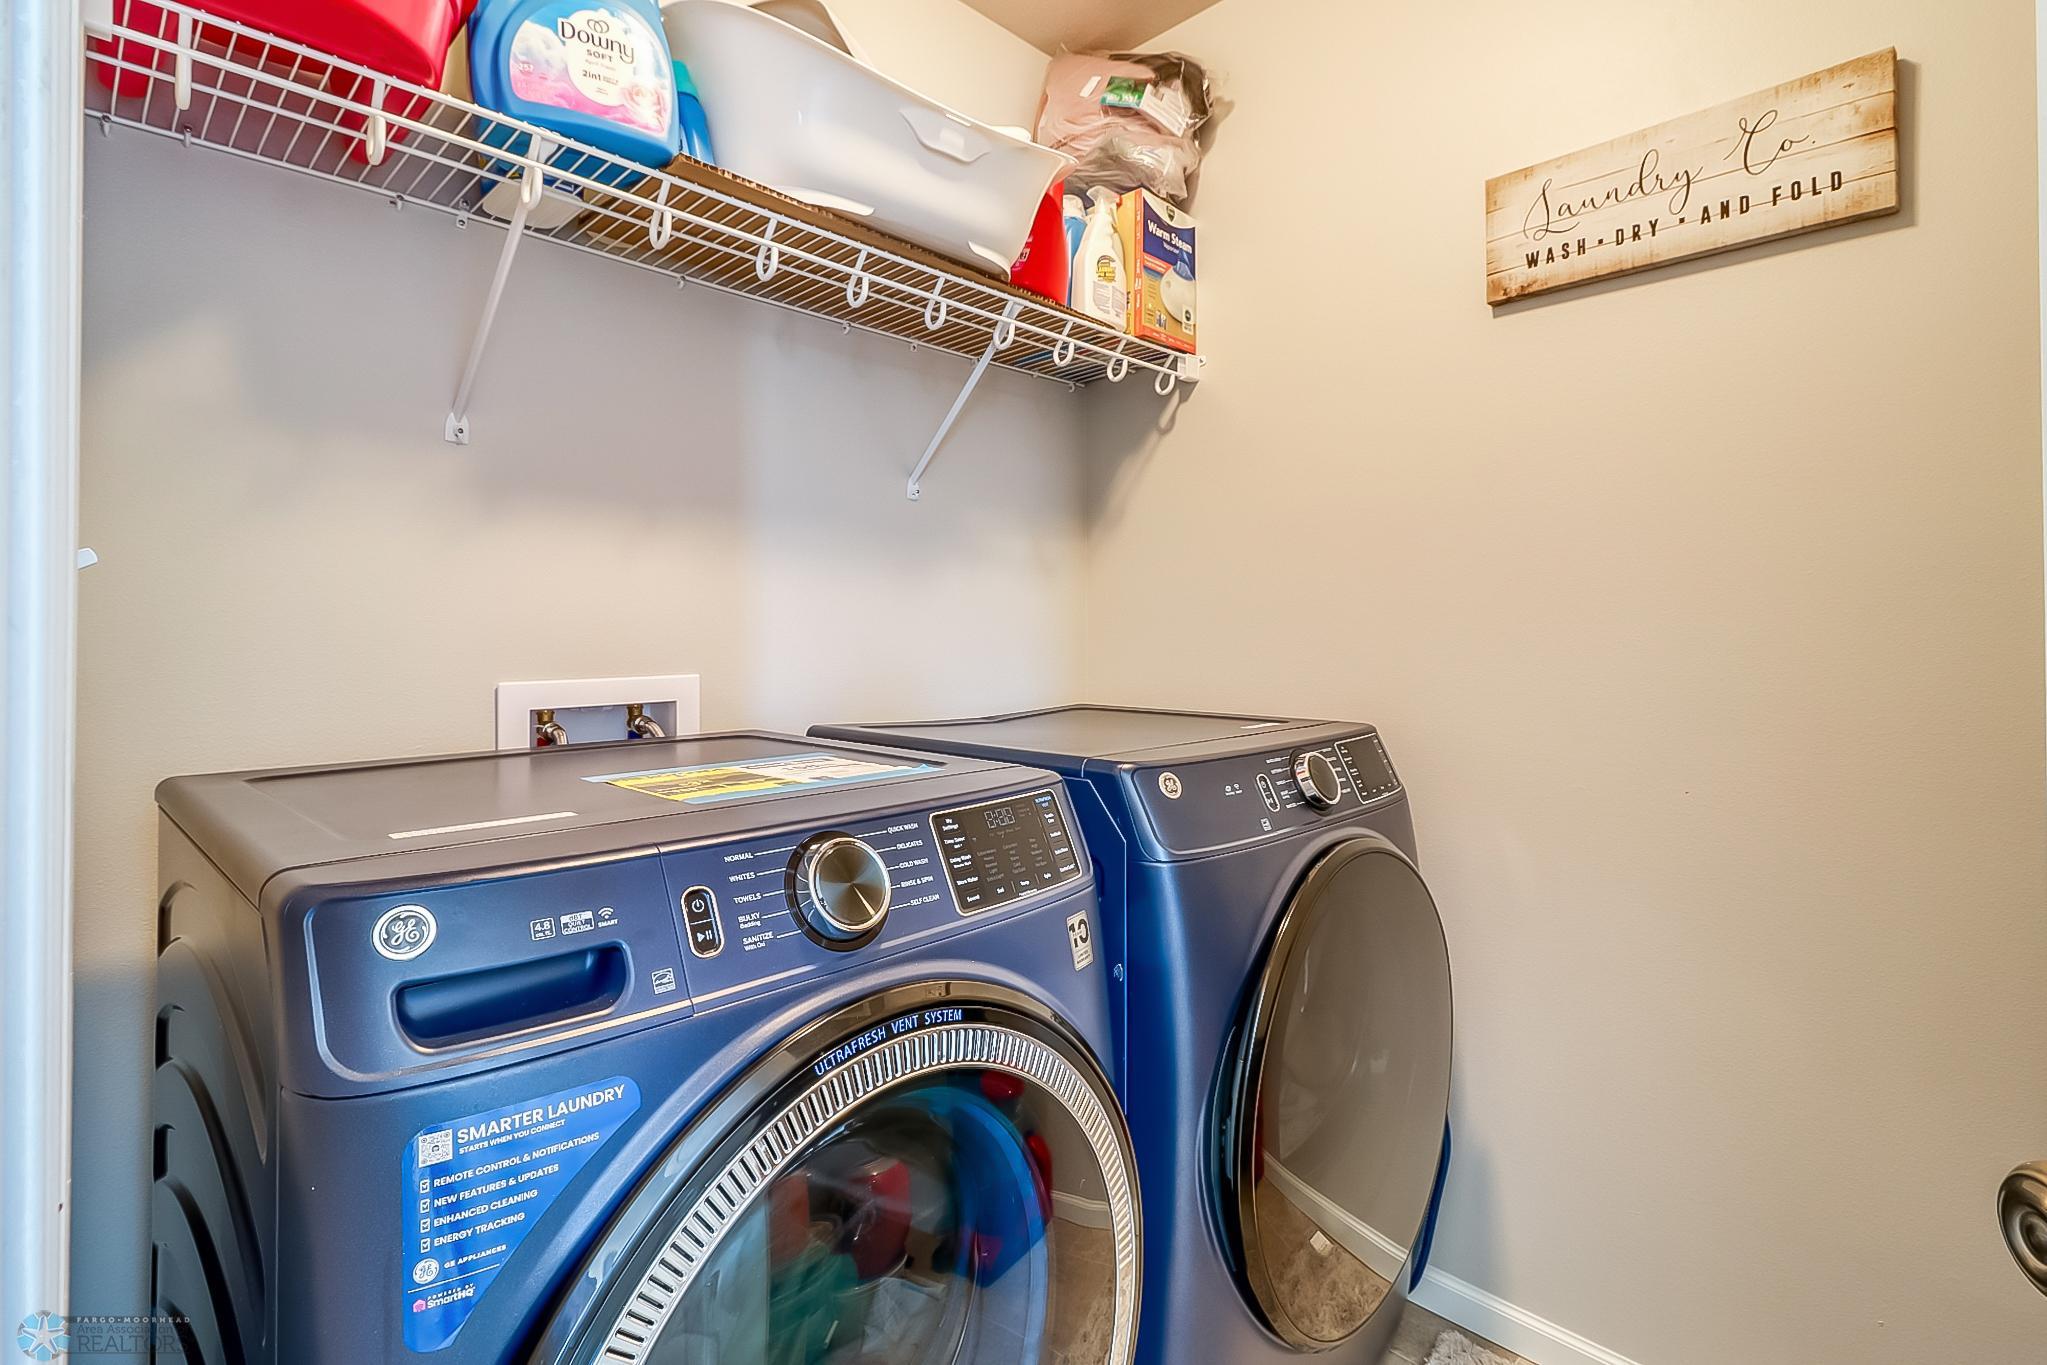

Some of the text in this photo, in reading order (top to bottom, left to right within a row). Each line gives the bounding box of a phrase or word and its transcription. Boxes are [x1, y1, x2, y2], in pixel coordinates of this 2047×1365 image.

[561, 20, 634, 65] Downy
[586, 49, 613, 63] SOFT
[1523, 109, 1817, 241] Laundry Co.
[1526, 169, 1843, 270] WASH DRY AND FOLD
[1147, 219, 1193, 255] Warm Steam
[904, 822, 919, 831] WASH
[896, 839, 924, 850] DELICATES
[723, 851, 754, 863] NORMAL
[899, 860, 913, 869] COLD
[728, 871, 756, 883] WHITES
[733, 892, 762, 904] TOWELS
[534, 921, 551, 932] 4.8
[597, 918, 618, 928] SMART
[737, 911, 761, 923] BULKY
[742, 931, 774, 944] SANITIZE
[815, 1008, 963, 1076] ULTRAFRESH VENT SYSTEM
[457, 1084, 625, 1144] SMARTER LAUNDRY
[458, 1119, 566, 1155] STARTS WHEN YOU CONNECT
[433, 1131, 600, 1188] REMOTE CONTROL & NOTIFICATIONS
[433, 1163, 560, 1208] NEW FEATURES & UPDATES
[433, 1189, 538, 1227] ENHANCED CLEANING
[433, 1212, 526, 1247] ENERGY TRACKING
[457, 1244, 507, 1265] APPLIANCES
[427, 1285, 476, 1309] SmartHQ
